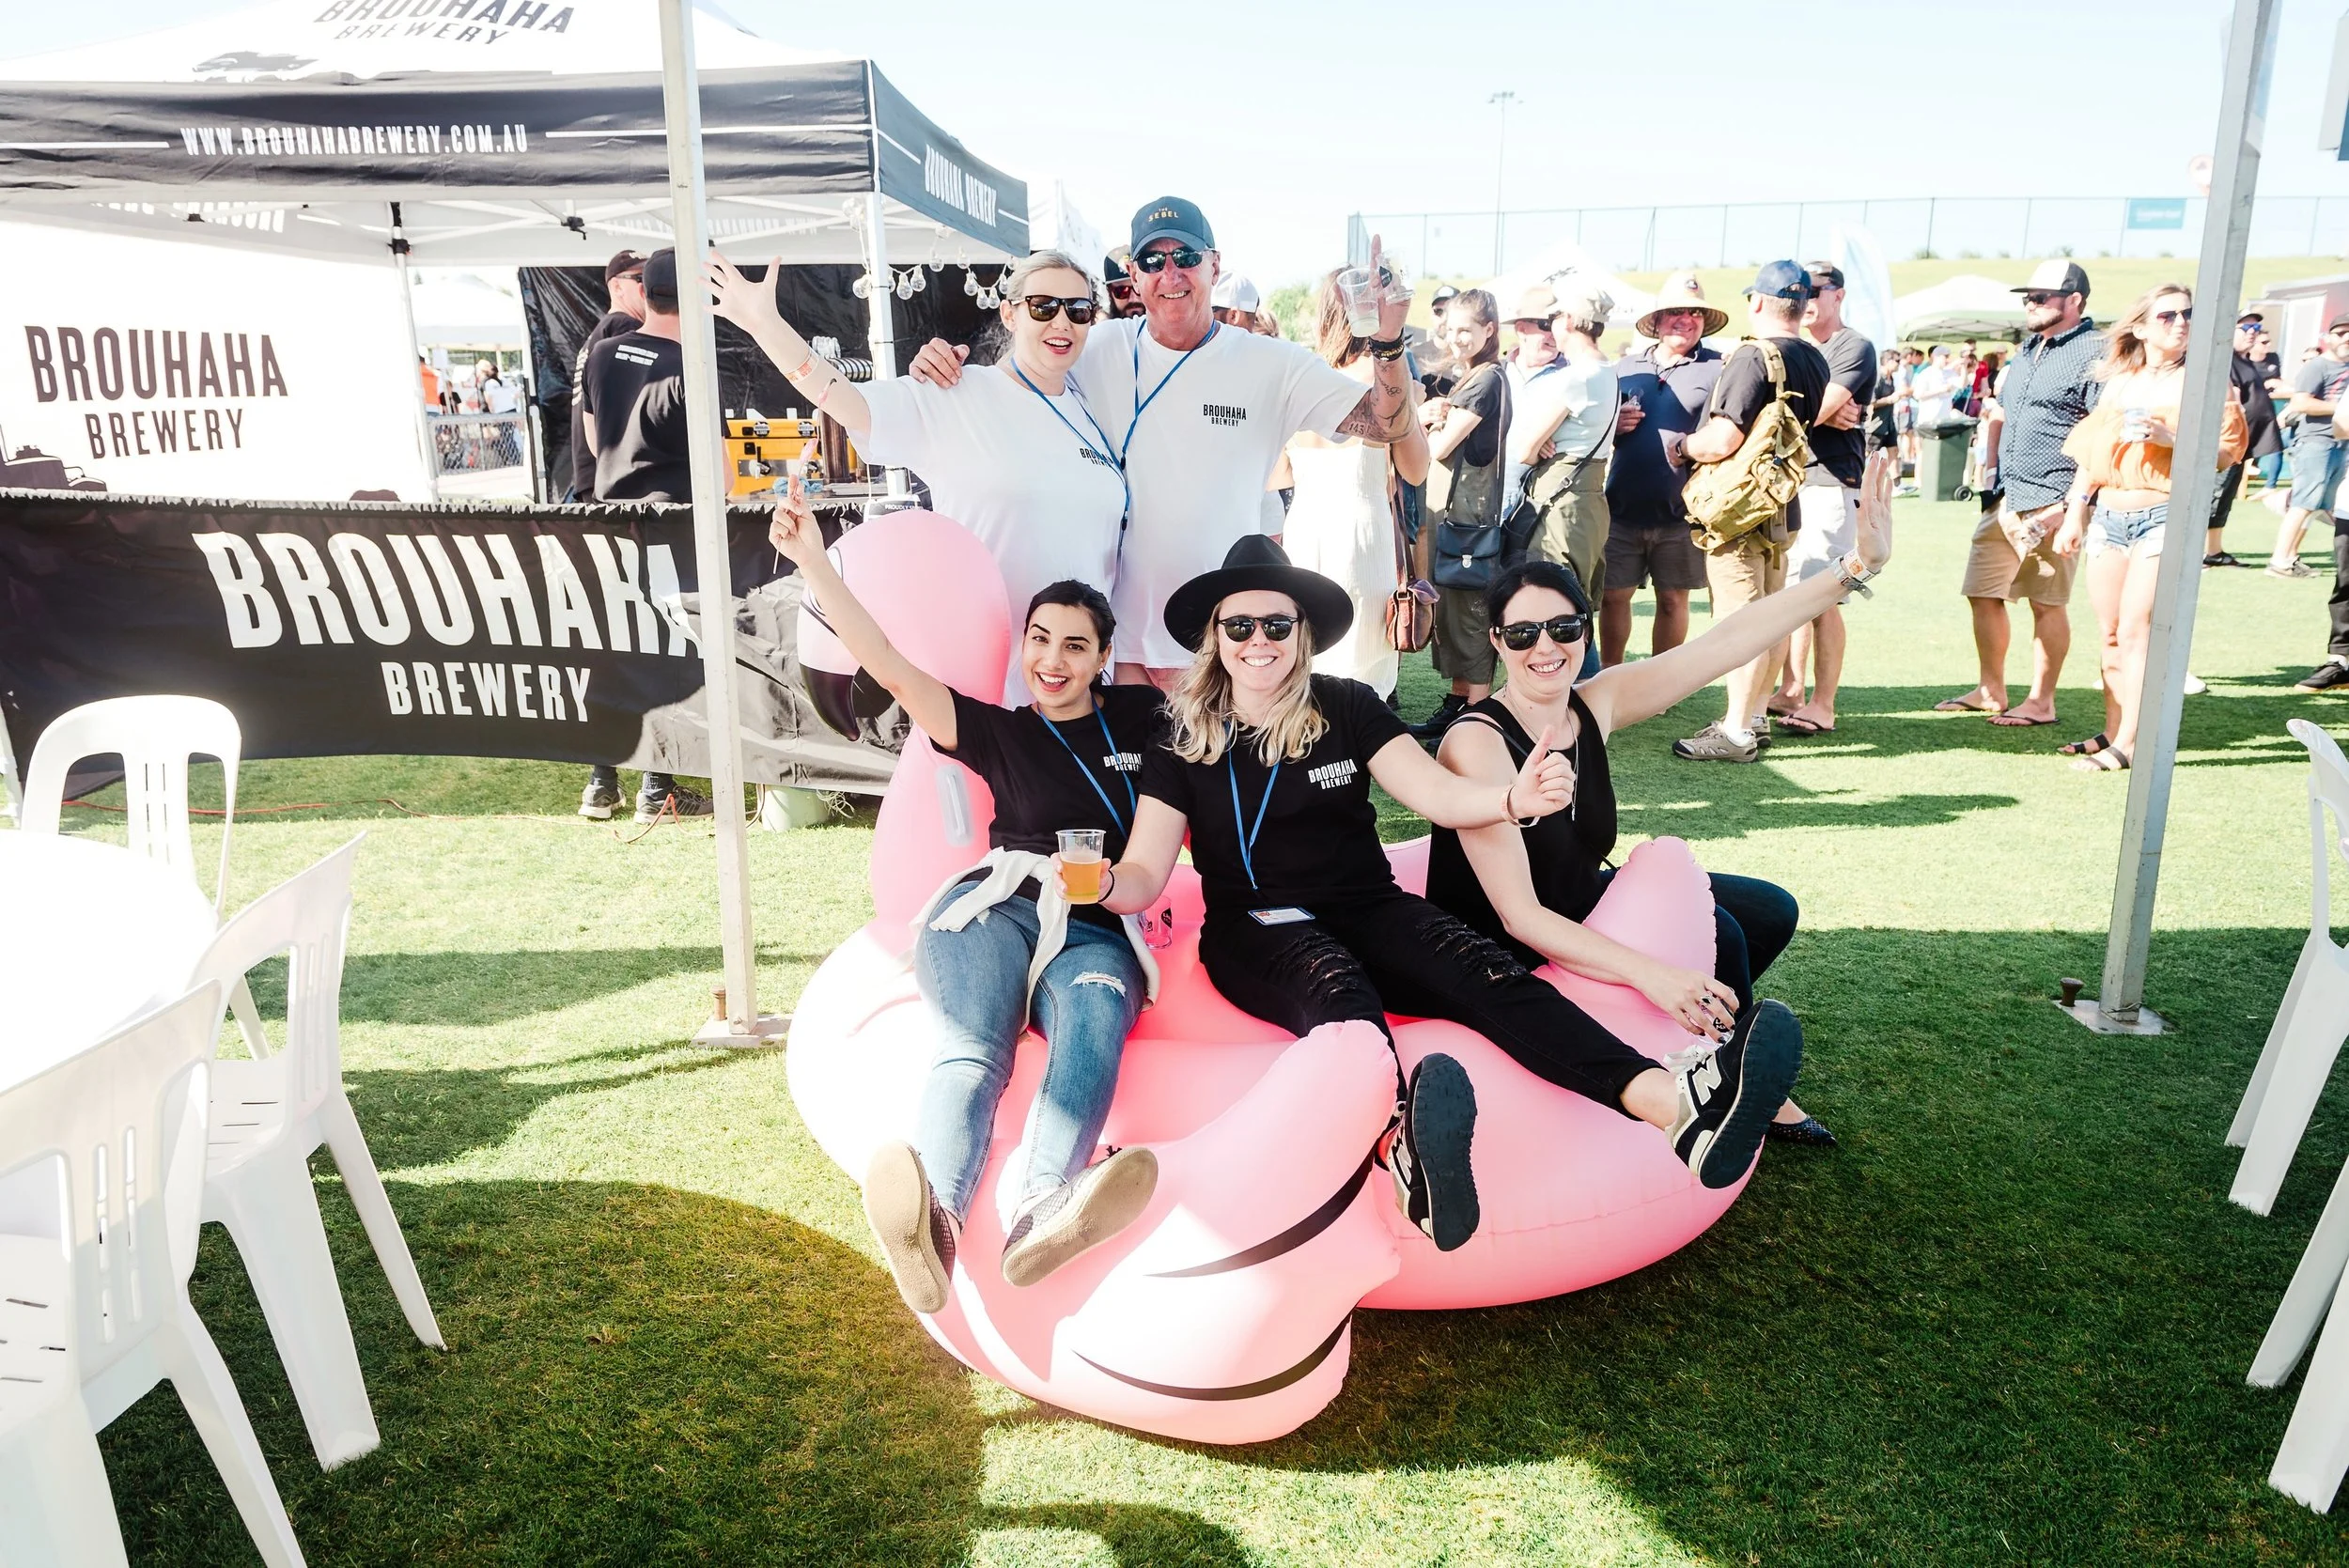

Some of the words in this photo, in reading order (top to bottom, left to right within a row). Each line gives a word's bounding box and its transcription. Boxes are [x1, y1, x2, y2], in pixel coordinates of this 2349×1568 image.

[313, 0, 575, 33] BROUHAHA
[334, 22, 509, 44] BREWERY
[179, 124, 528, 156] WWW.BROUHAHABREWERY.COM.AU
[1148, 211, 1179, 222] SEBEL
[24, 325, 288, 402] BROUHAHA
[1203, 404, 1247, 420] BROUHAHA
[1211, 416, 1239, 427] BREWERY
[85, 409, 242, 458] BREWERY
[192, 531, 705, 660] BROUHAHA
[381, 661, 591, 722] BREWERY
[1307, 758, 1359, 784] BROUHAHA
[1320, 774, 1352, 790] BREWERY
